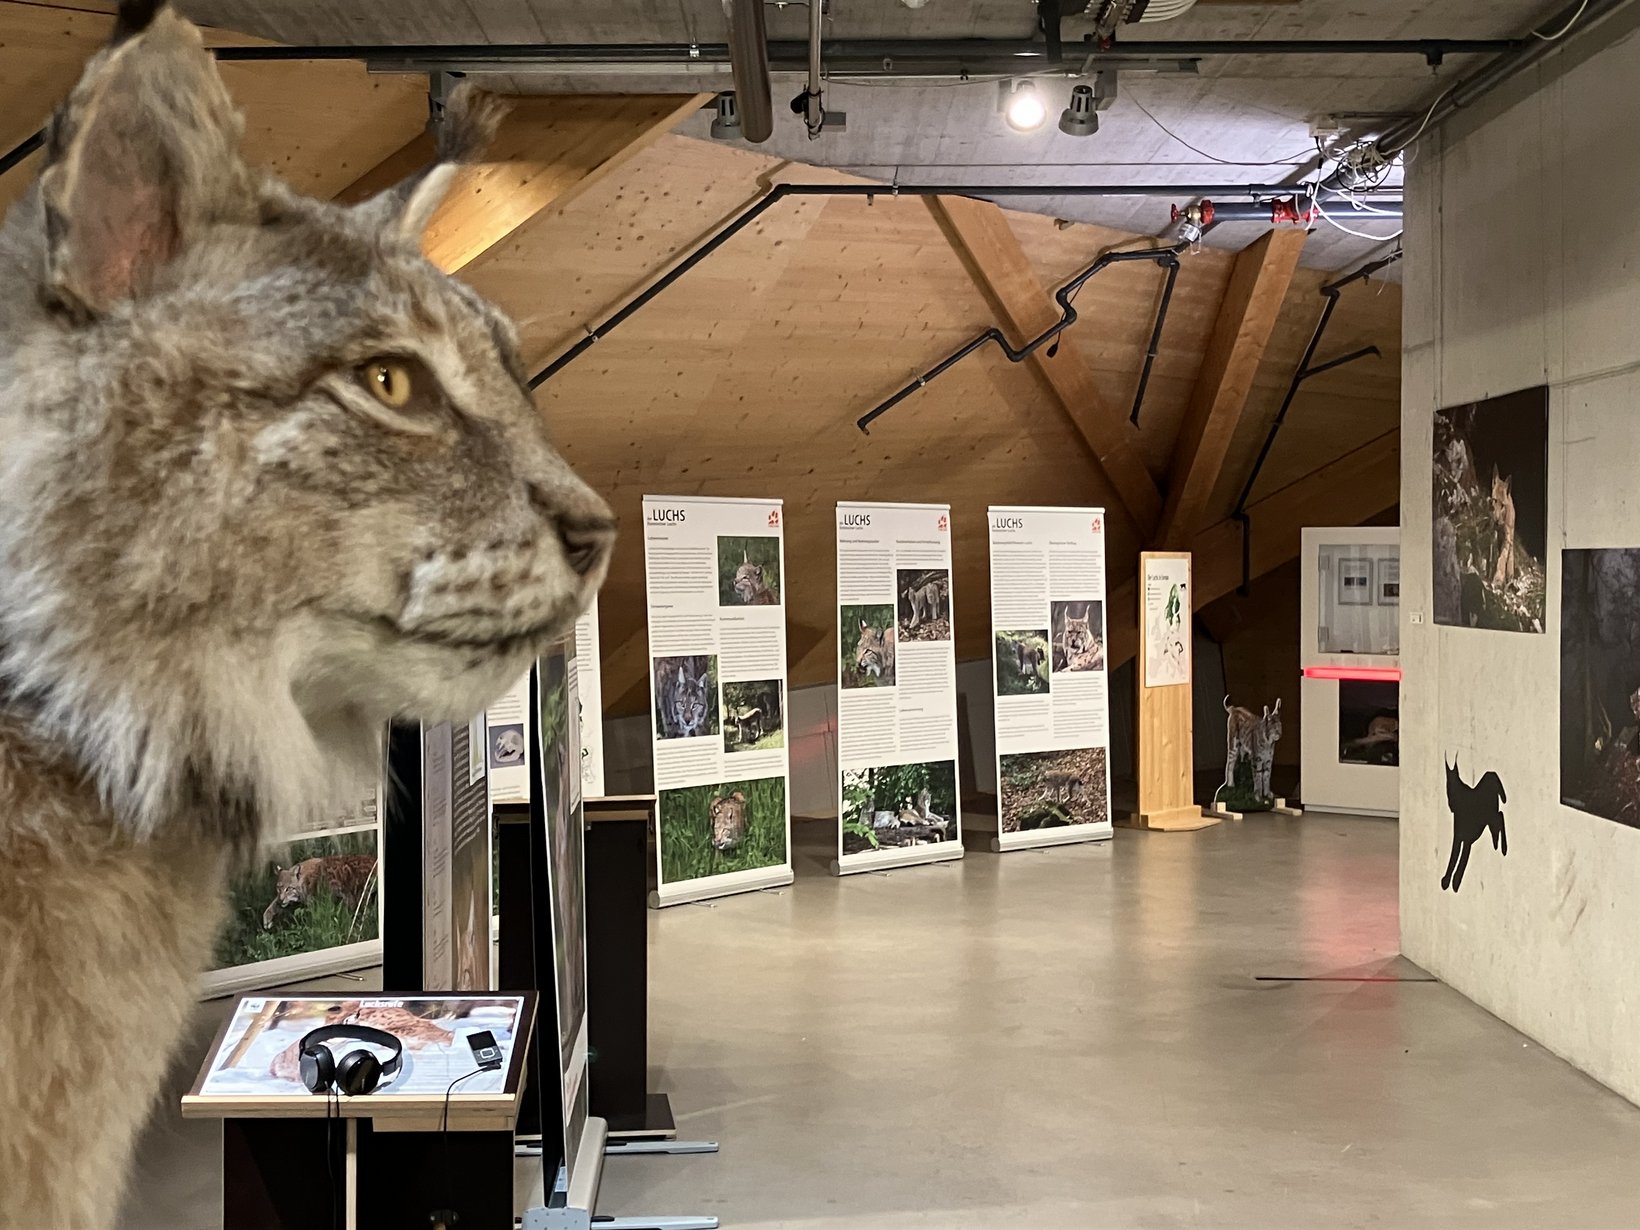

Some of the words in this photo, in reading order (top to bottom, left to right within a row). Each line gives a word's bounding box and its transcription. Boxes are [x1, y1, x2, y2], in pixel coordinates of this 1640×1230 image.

[653, 509, 686, 521] LUCHS
[844, 514, 871, 526] LUCHS
[996, 518, 1023, 529] LUCHS
[359, 999, 404, 1008] Luchsrufe
